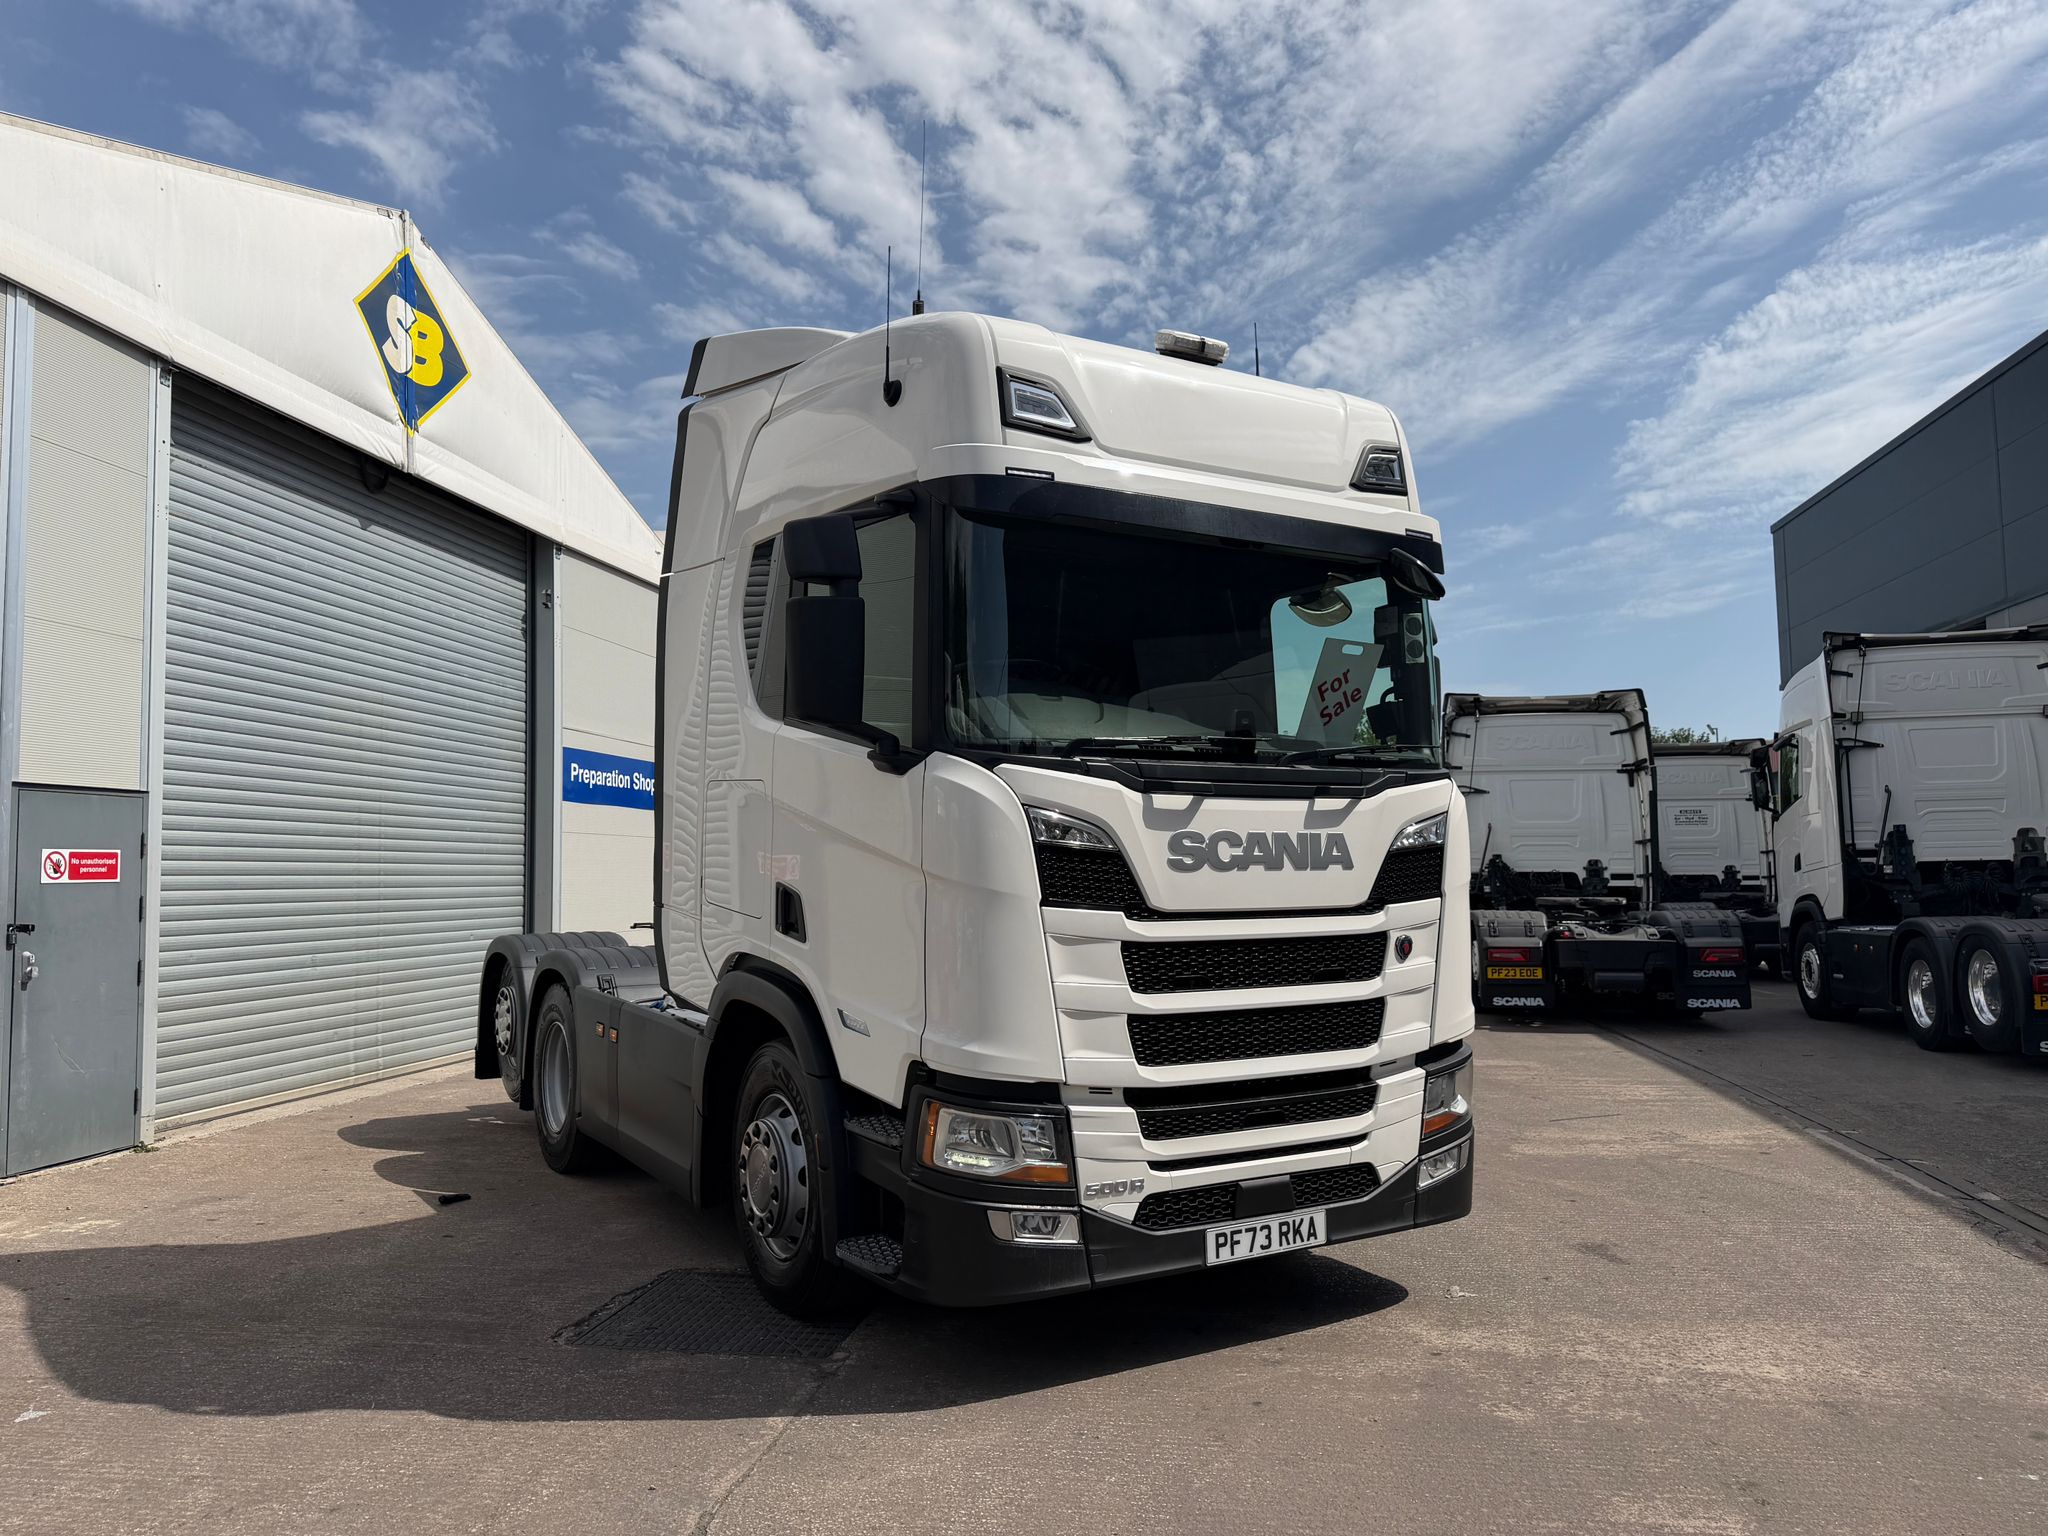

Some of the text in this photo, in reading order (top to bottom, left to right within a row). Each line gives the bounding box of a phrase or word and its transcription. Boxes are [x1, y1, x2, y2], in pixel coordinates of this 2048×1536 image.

[1317, 668, 1350, 702] For
[1320, 687, 1362, 727] Sale
[570, 762, 631, 789] Preparation
[1166, 829, 1355, 873] SCANIA
[80, 857, 116, 865] unauthorised
[80, 866, 107, 874] personnel
[1491, 968, 1518, 977] PF23
[1692, 969, 1737, 978] SCANIA
[1492, 996, 1545, 1006] SCANIA
[1686, 998, 1741, 1008] SCANIA
[1215, 1216, 1318, 1260] PF73 RKA
